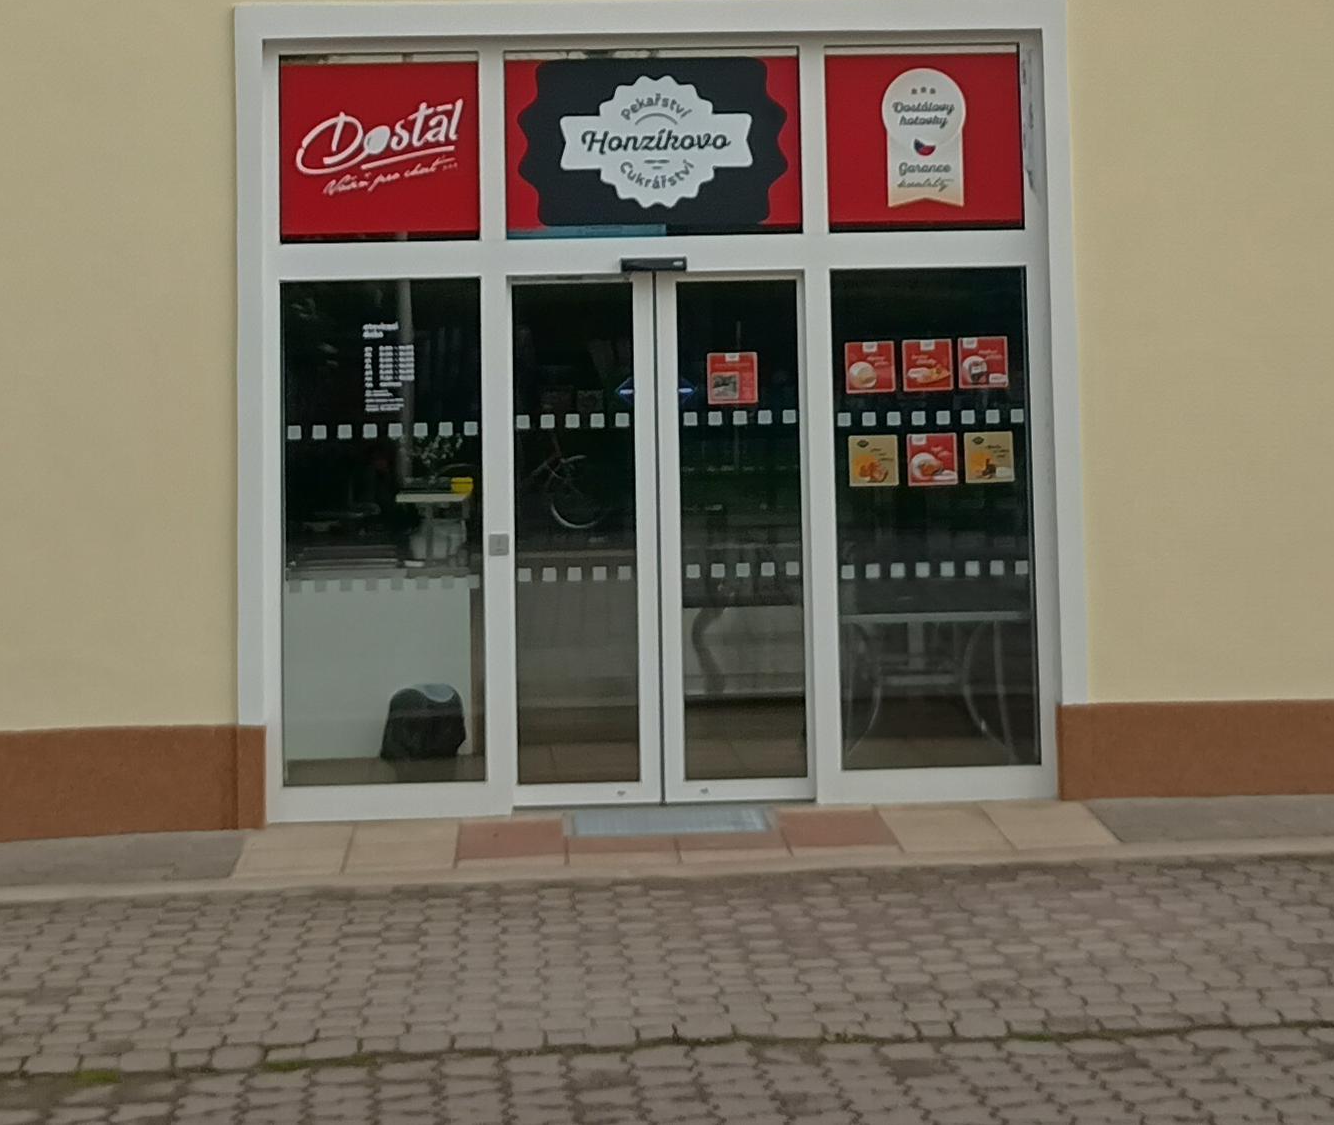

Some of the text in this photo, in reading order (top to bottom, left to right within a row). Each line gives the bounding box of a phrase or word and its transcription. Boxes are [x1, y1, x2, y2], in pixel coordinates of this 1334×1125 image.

[296, 98, 464, 174] Dostál
[581, 128, 731, 155] Honzíkovo
[620, 159, 695, 190] Cukrářství
